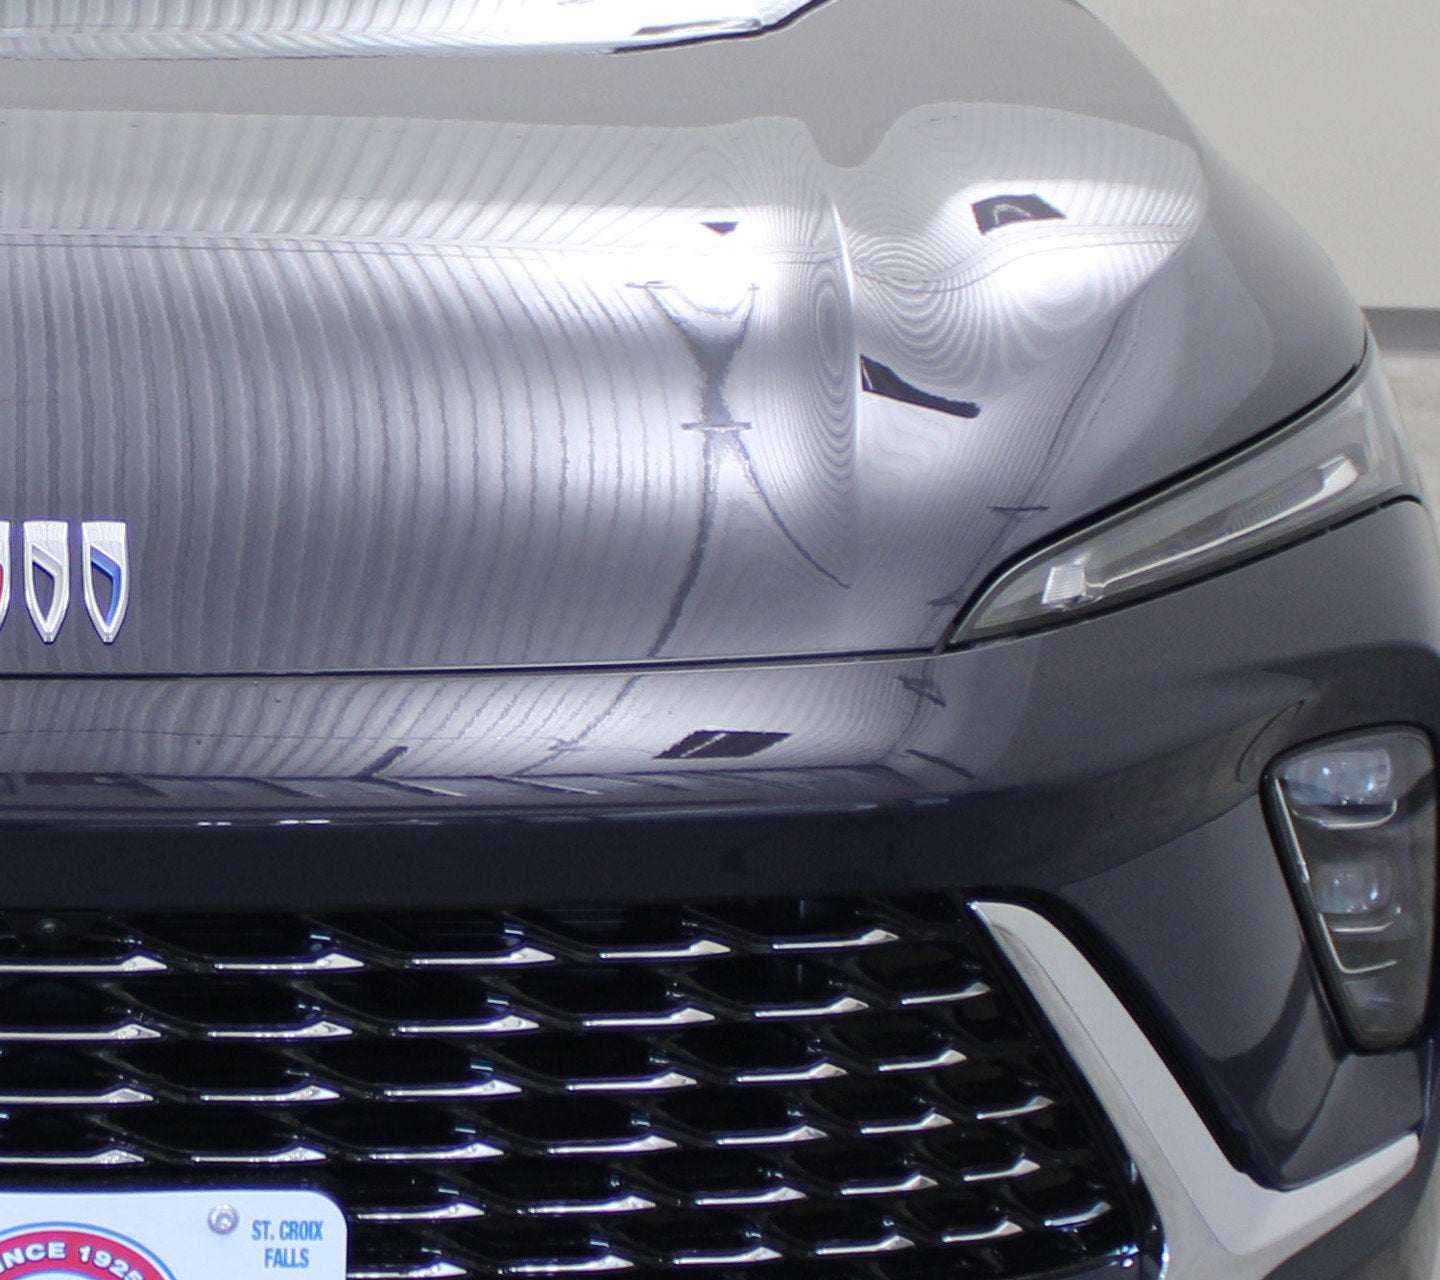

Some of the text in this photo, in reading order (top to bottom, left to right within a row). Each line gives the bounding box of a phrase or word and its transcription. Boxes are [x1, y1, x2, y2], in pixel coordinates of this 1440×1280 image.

[252, 1220, 324, 1241] ST. CROIX
[264, 1247, 310, 1268] FALLS
